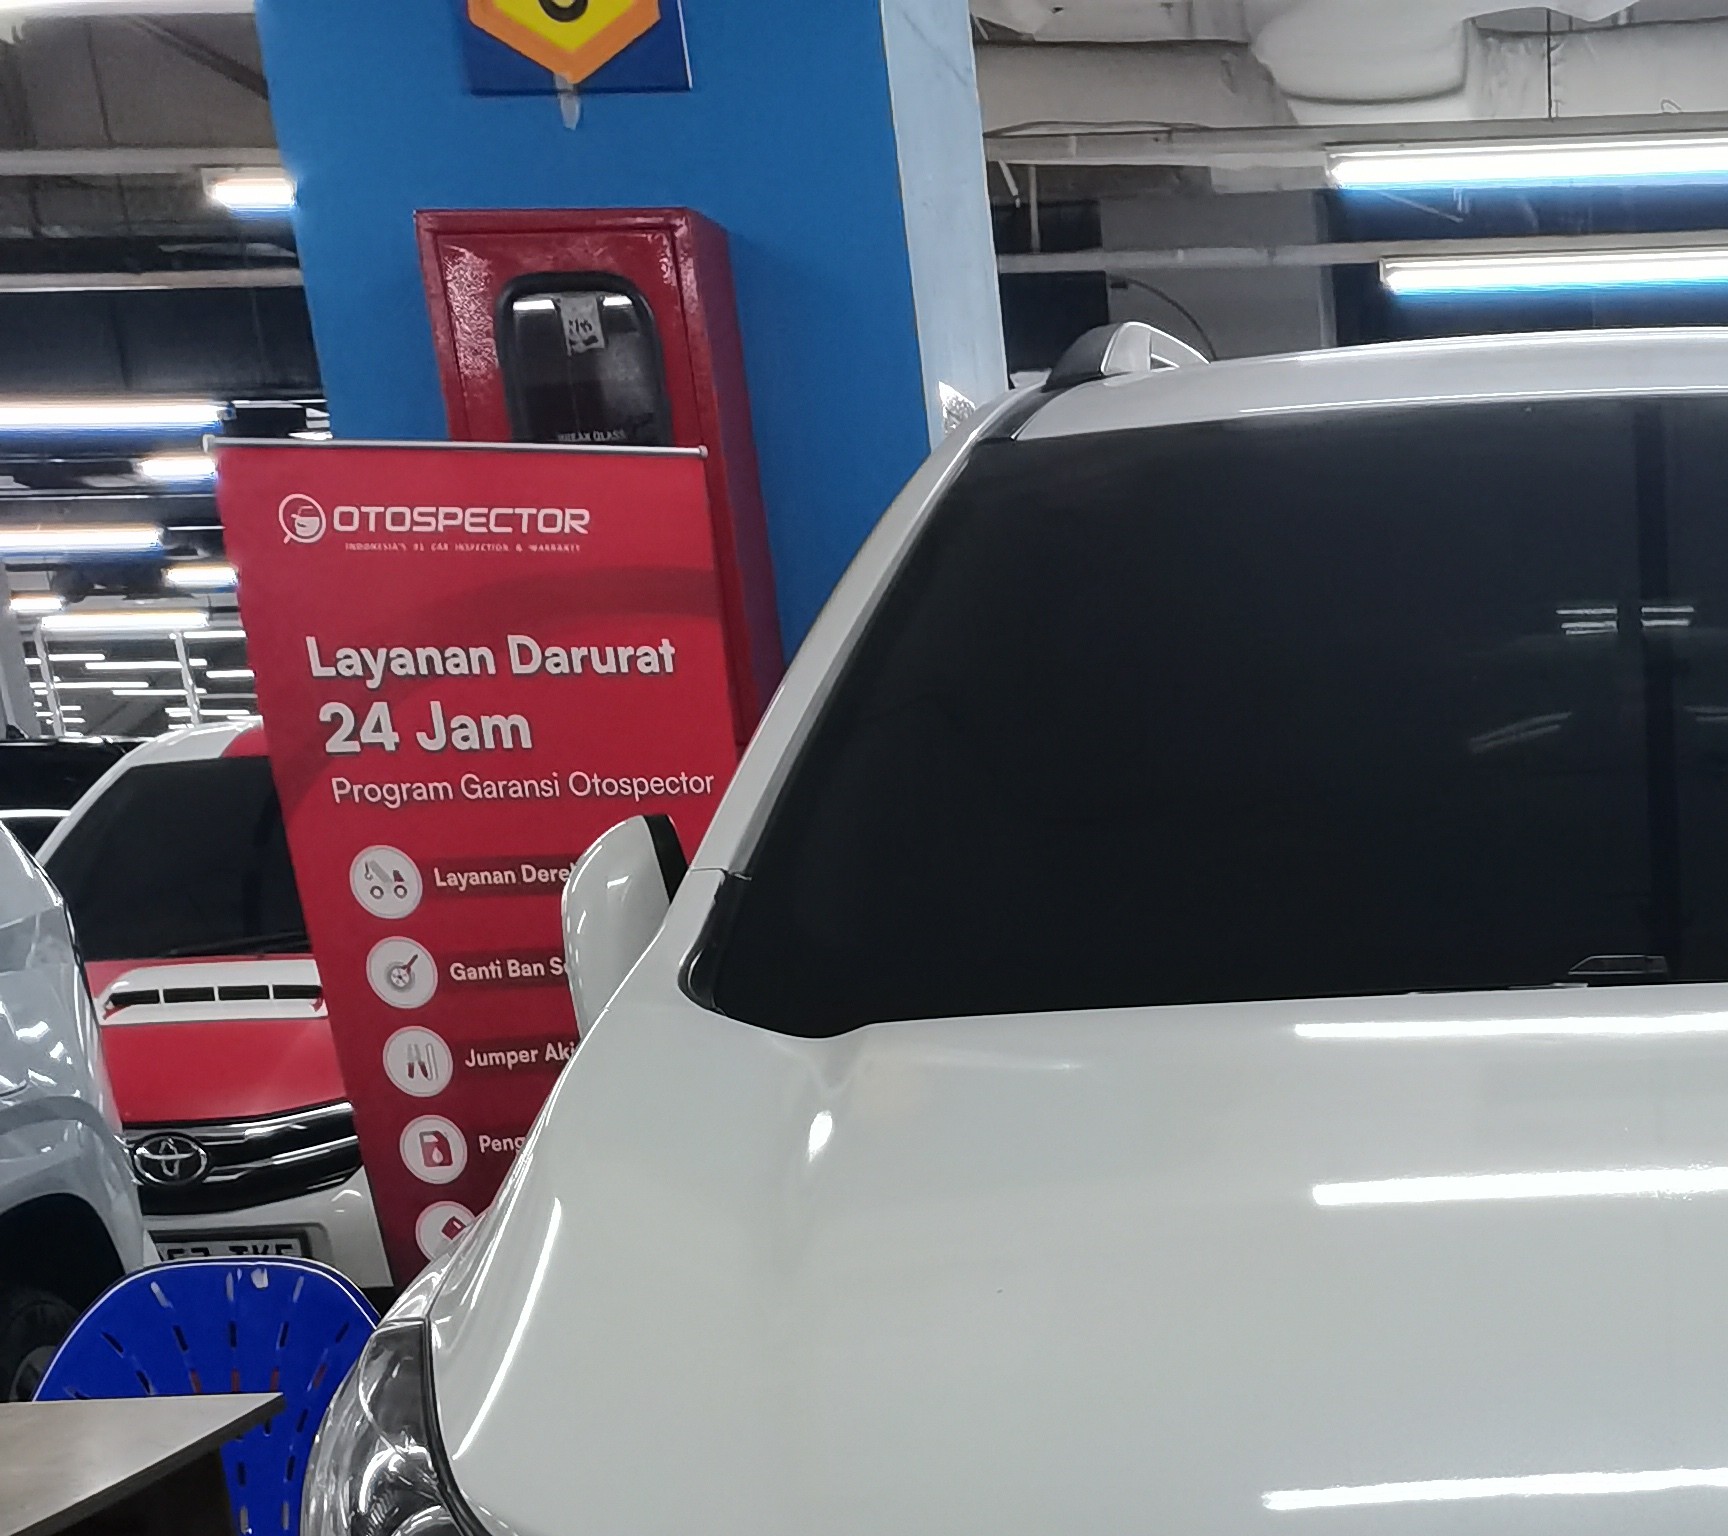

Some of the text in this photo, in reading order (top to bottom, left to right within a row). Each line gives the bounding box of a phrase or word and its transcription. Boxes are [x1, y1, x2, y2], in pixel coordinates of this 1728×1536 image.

[332, 505, 591, 535] OTOSPECTOR
[305, 634, 676, 689] Layanan Darurat
[318, 701, 533, 755] 24 Jam
[331, 771, 714, 809] Program Garansi Otospector
[434, 867, 517, 891] Layanan
[450, 959, 502, 981] Ganti
[507, 959, 545, 978] Ban
[465, 1041, 575, 1070] Jumper Aki
